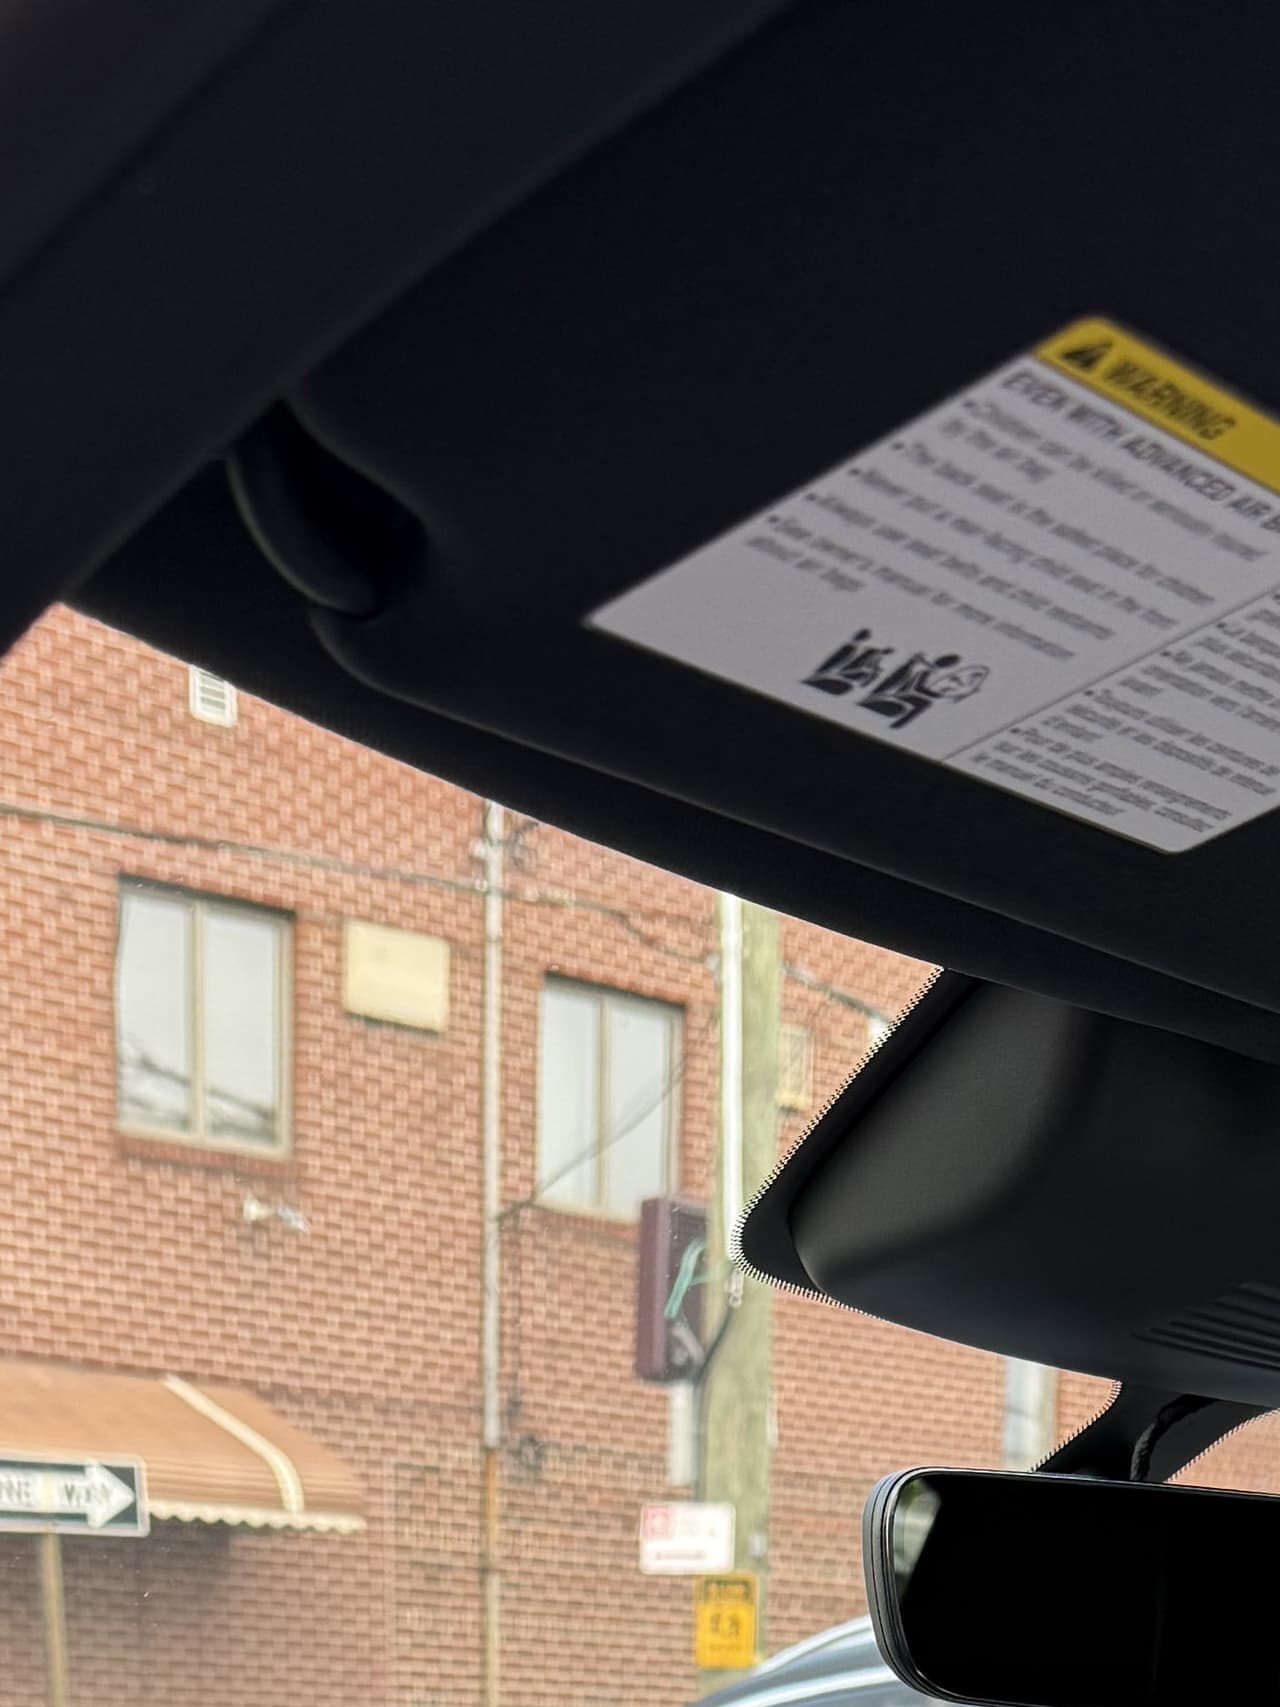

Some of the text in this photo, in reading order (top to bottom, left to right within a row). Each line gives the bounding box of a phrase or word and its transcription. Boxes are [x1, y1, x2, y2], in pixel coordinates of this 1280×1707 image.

[1001, 369, 1076, 412] EVEN
[1061, 402, 1131, 442] WITH
[1117, 433, 1239, 502] ADVANCED
[1225, 493, 1274, 520] AIR
[1096, 356, 1241, 442] WARNING
